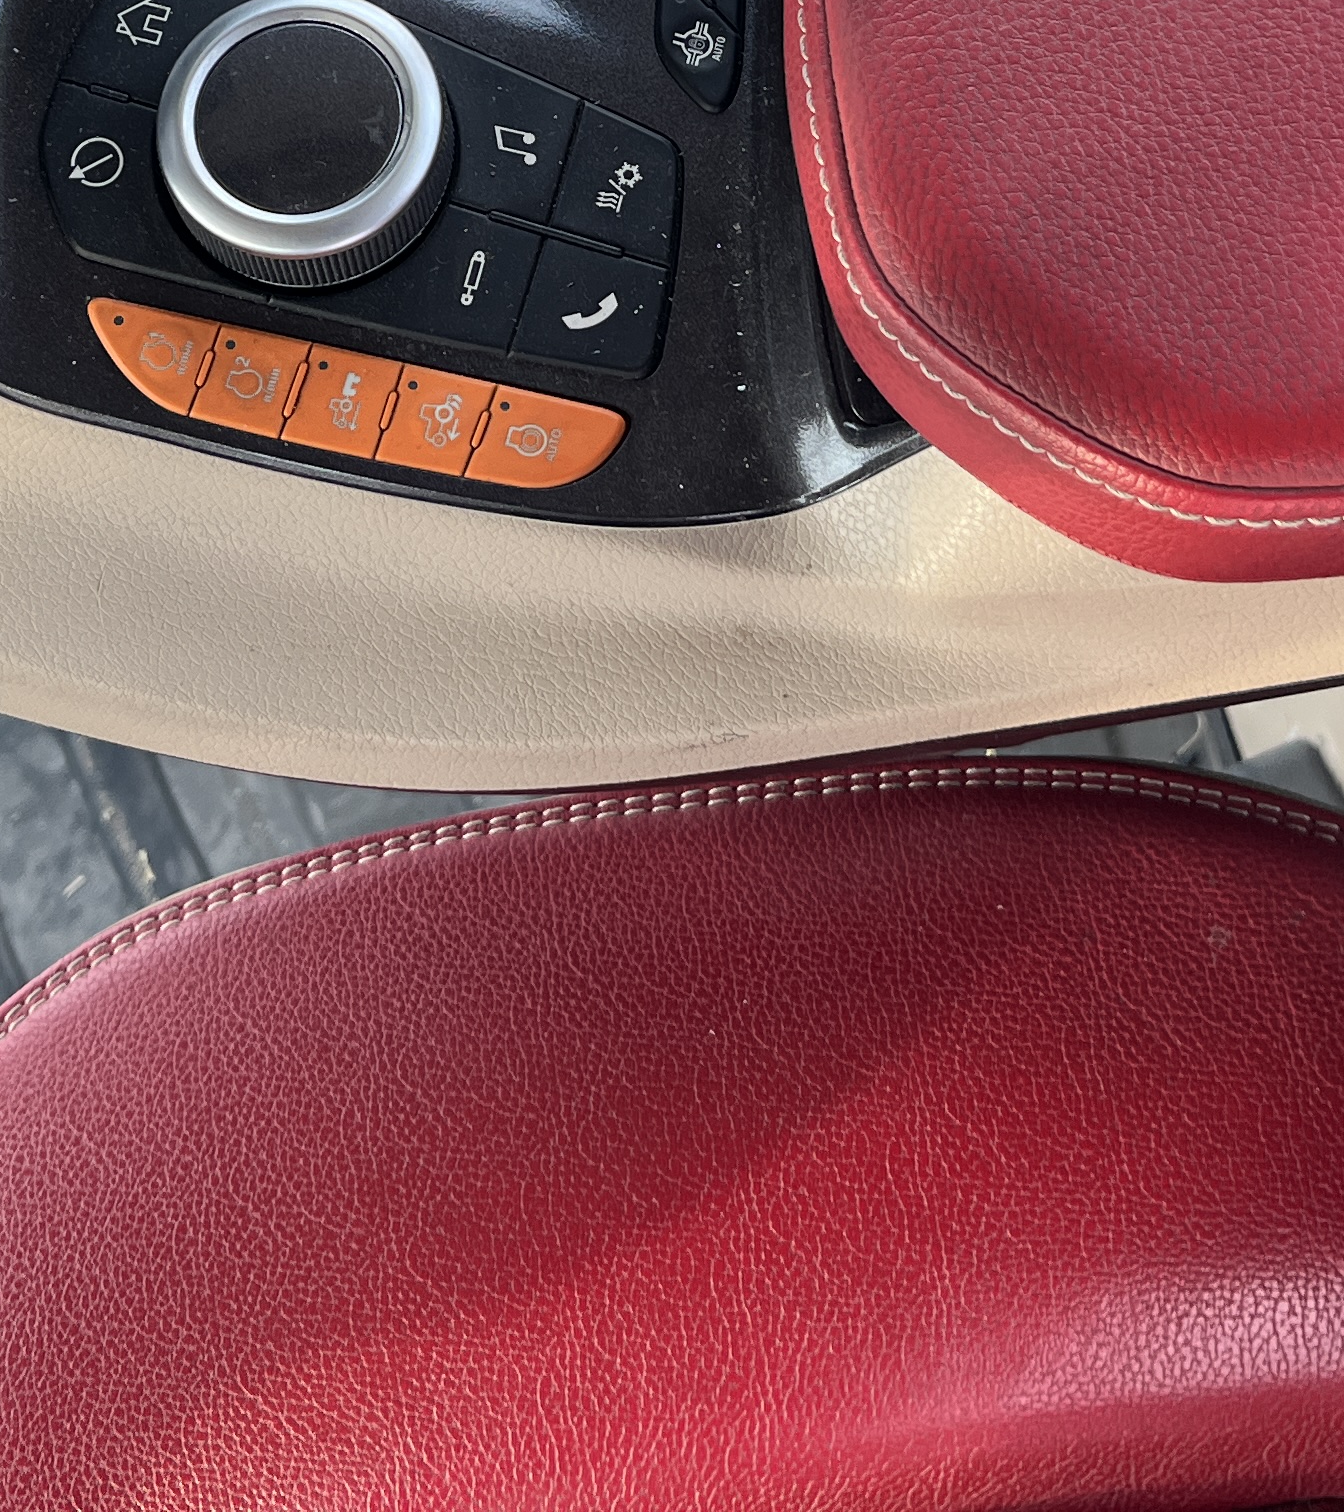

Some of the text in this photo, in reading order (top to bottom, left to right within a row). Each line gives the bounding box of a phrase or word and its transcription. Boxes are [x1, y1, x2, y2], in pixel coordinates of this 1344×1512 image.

[711, 36, 726, 62] AUTO
[234, 356, 251, 368] 2
[546, 427, 563, 463] AUTO
